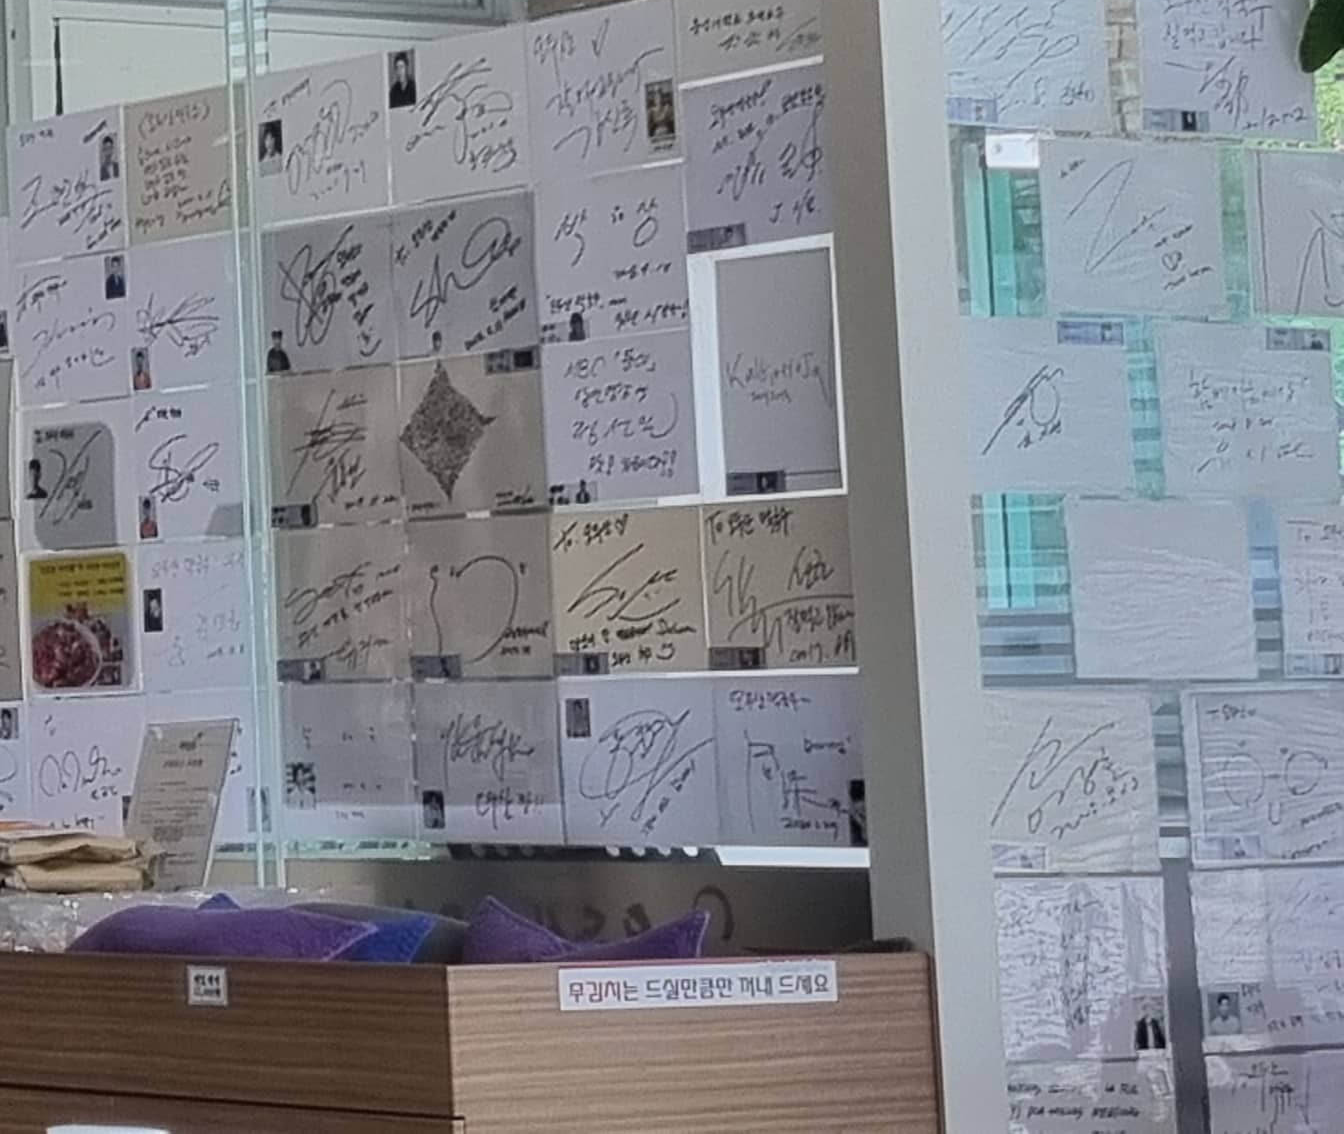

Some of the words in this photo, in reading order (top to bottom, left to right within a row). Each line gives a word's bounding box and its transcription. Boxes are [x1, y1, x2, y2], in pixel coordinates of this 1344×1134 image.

[645, 977, 733, 1000] 드실만큼만
[739, 975, 774, 997] 꺼내
[777, 973, 829, 996] 드세요
